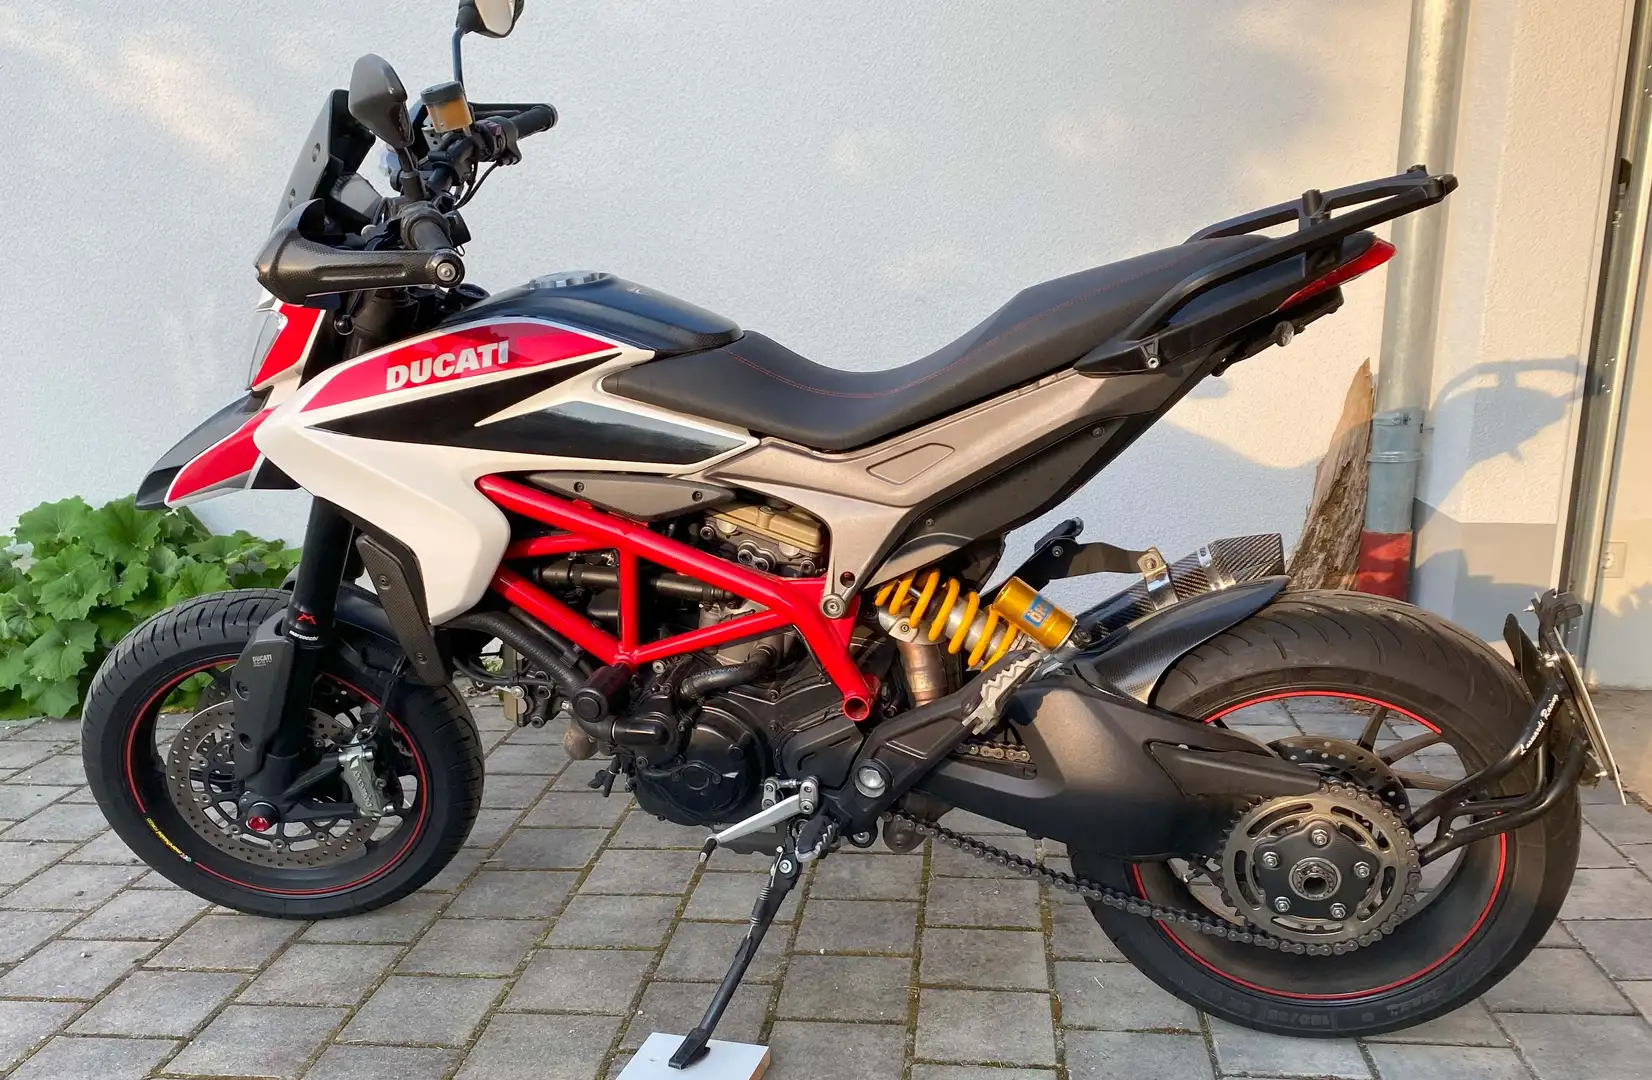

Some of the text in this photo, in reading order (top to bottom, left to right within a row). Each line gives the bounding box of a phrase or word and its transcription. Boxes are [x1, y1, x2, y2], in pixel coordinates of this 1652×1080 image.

[385, 340, 509, 391] DUCATI
[252, 654, 272, 662] DUCATI
[1540, 693, 1559, 720] Racing
